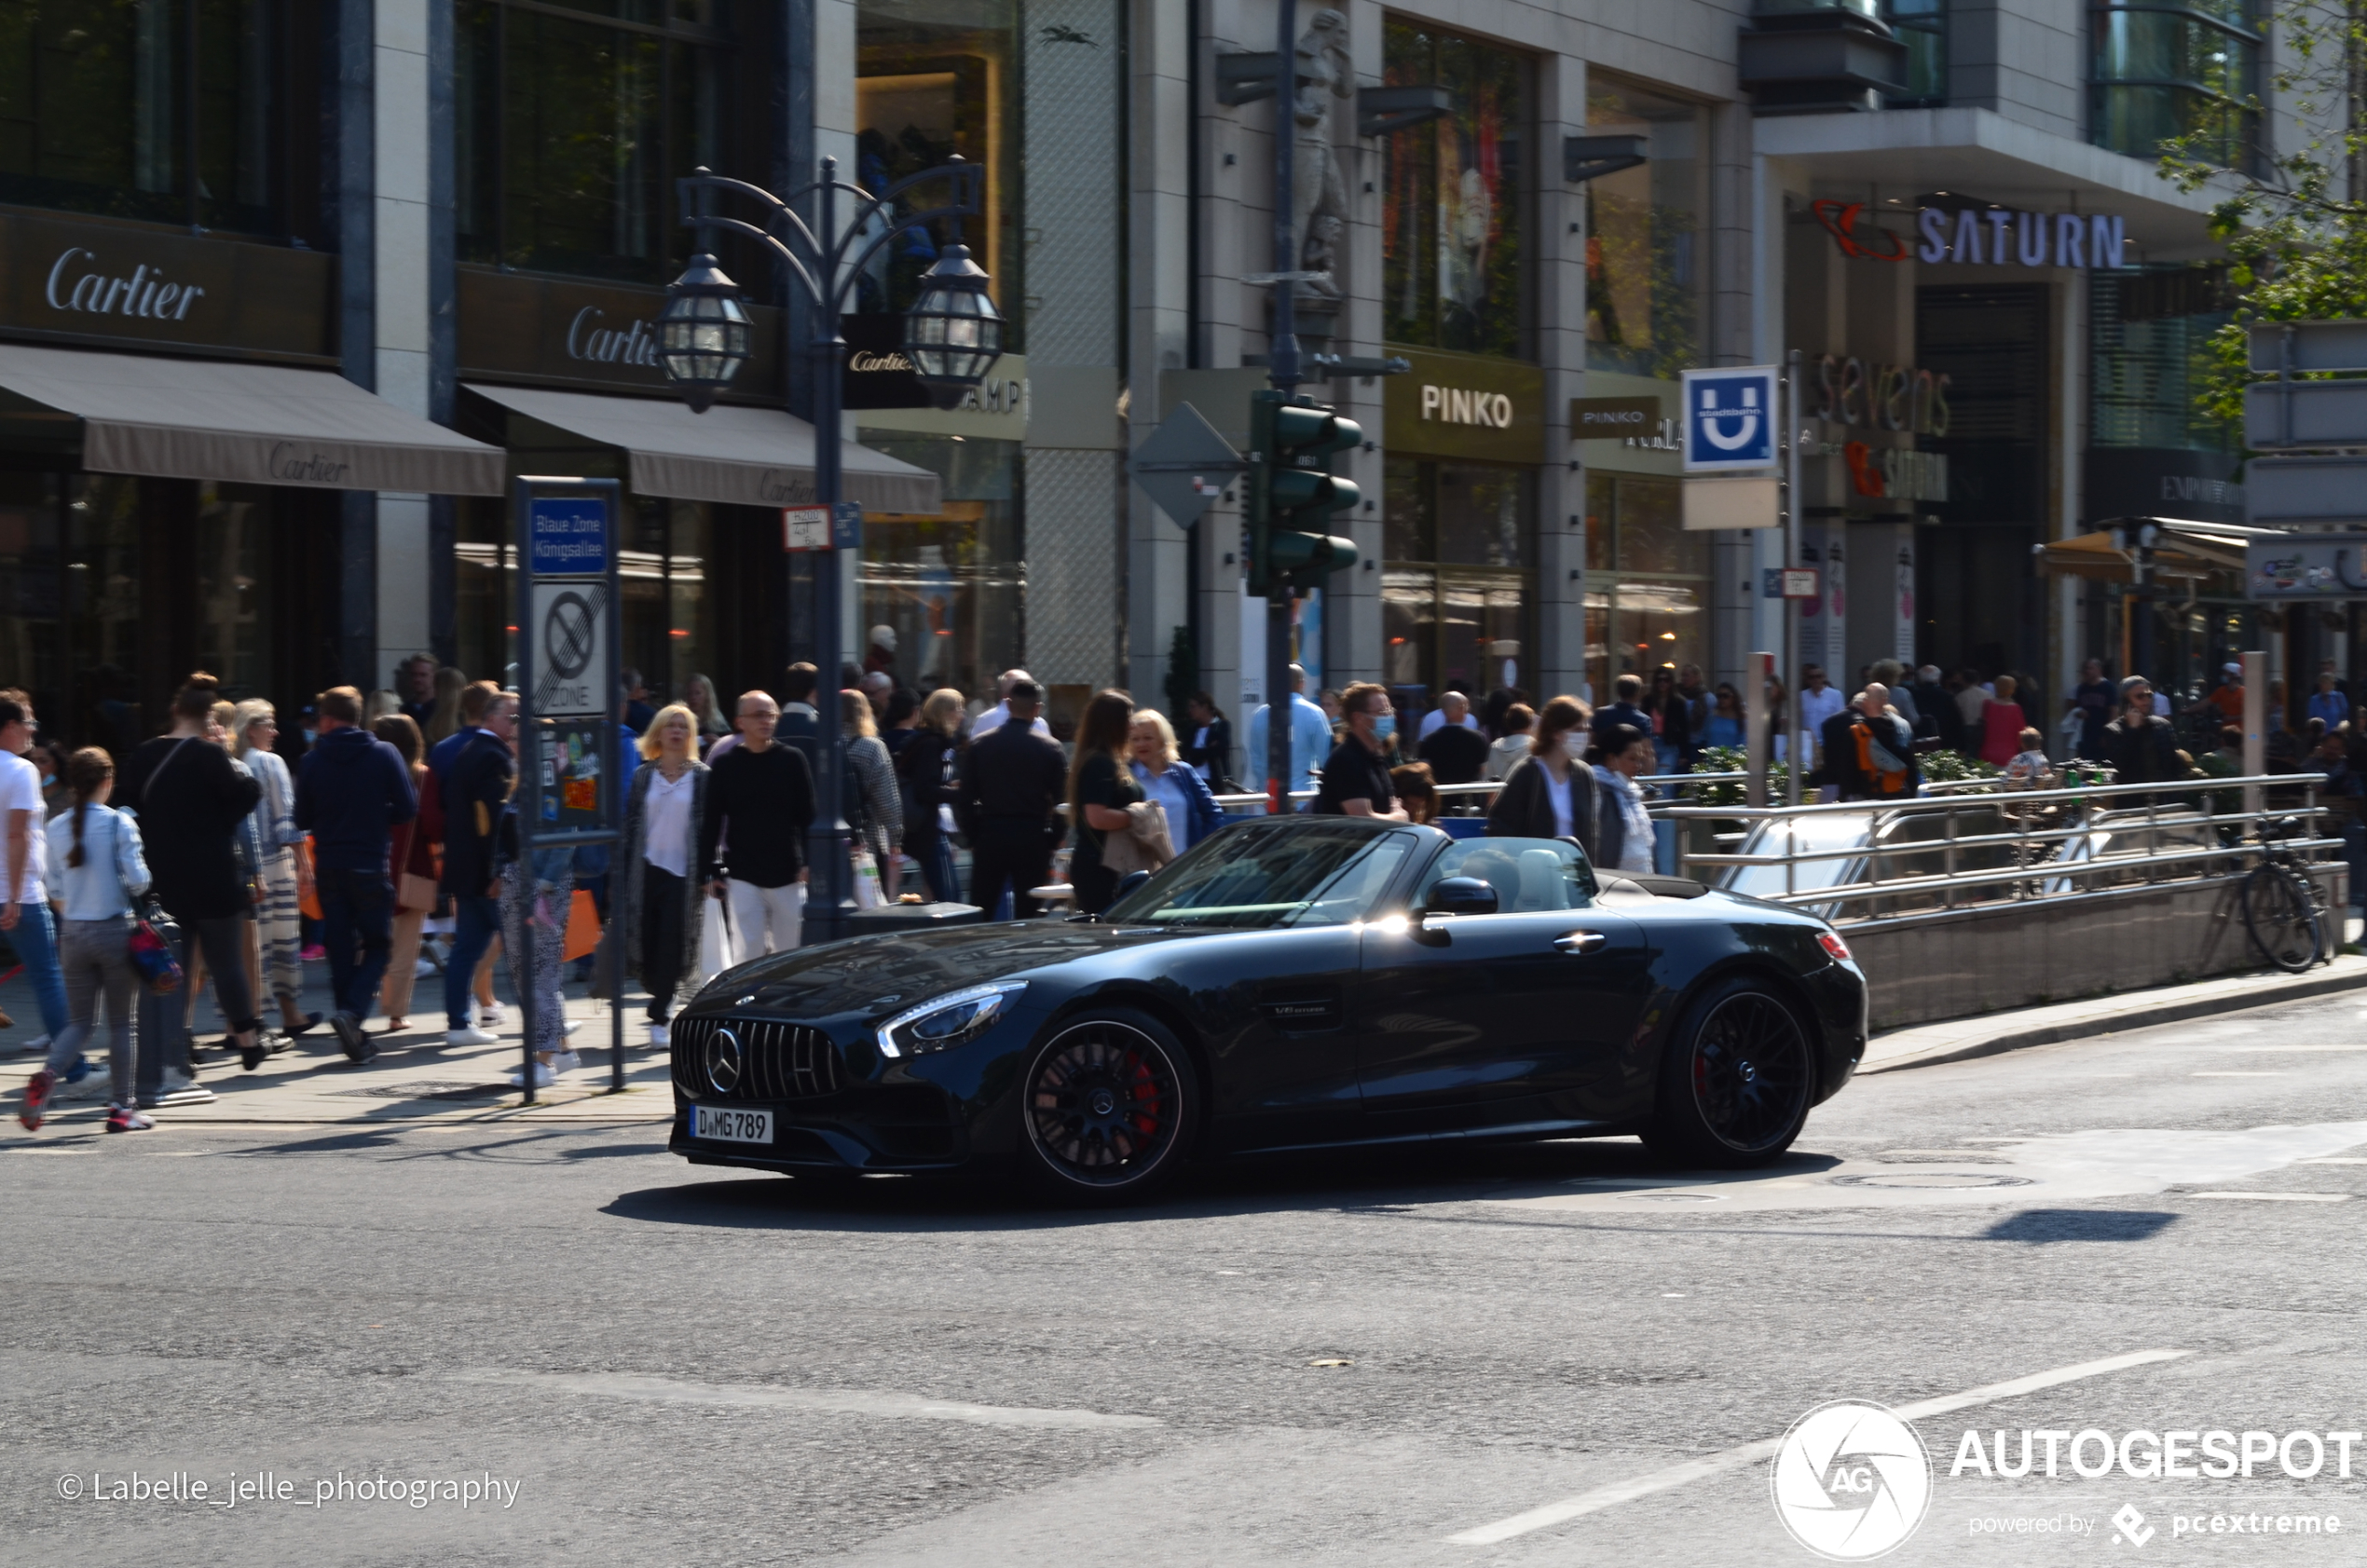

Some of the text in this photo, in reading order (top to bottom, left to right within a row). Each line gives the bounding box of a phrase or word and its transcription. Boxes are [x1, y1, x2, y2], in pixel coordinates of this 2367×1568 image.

[1918, 206, 2126, 268] SATURN
[45, 246, 205, 320] Cartier
[567, 304, 658, 367] Carti
[1420, 383, 1513, 429] PINKO
[1582, 410, 1647, 425] PINKO
[268, 440, 349, 483] Cartier
[536, 514, 601, 532] Blaue Zone
[535, 539, 603, 562] Königsallee
[550, 686, 590, 707] ZONE
[735, 1112, 766, 1139] 789
